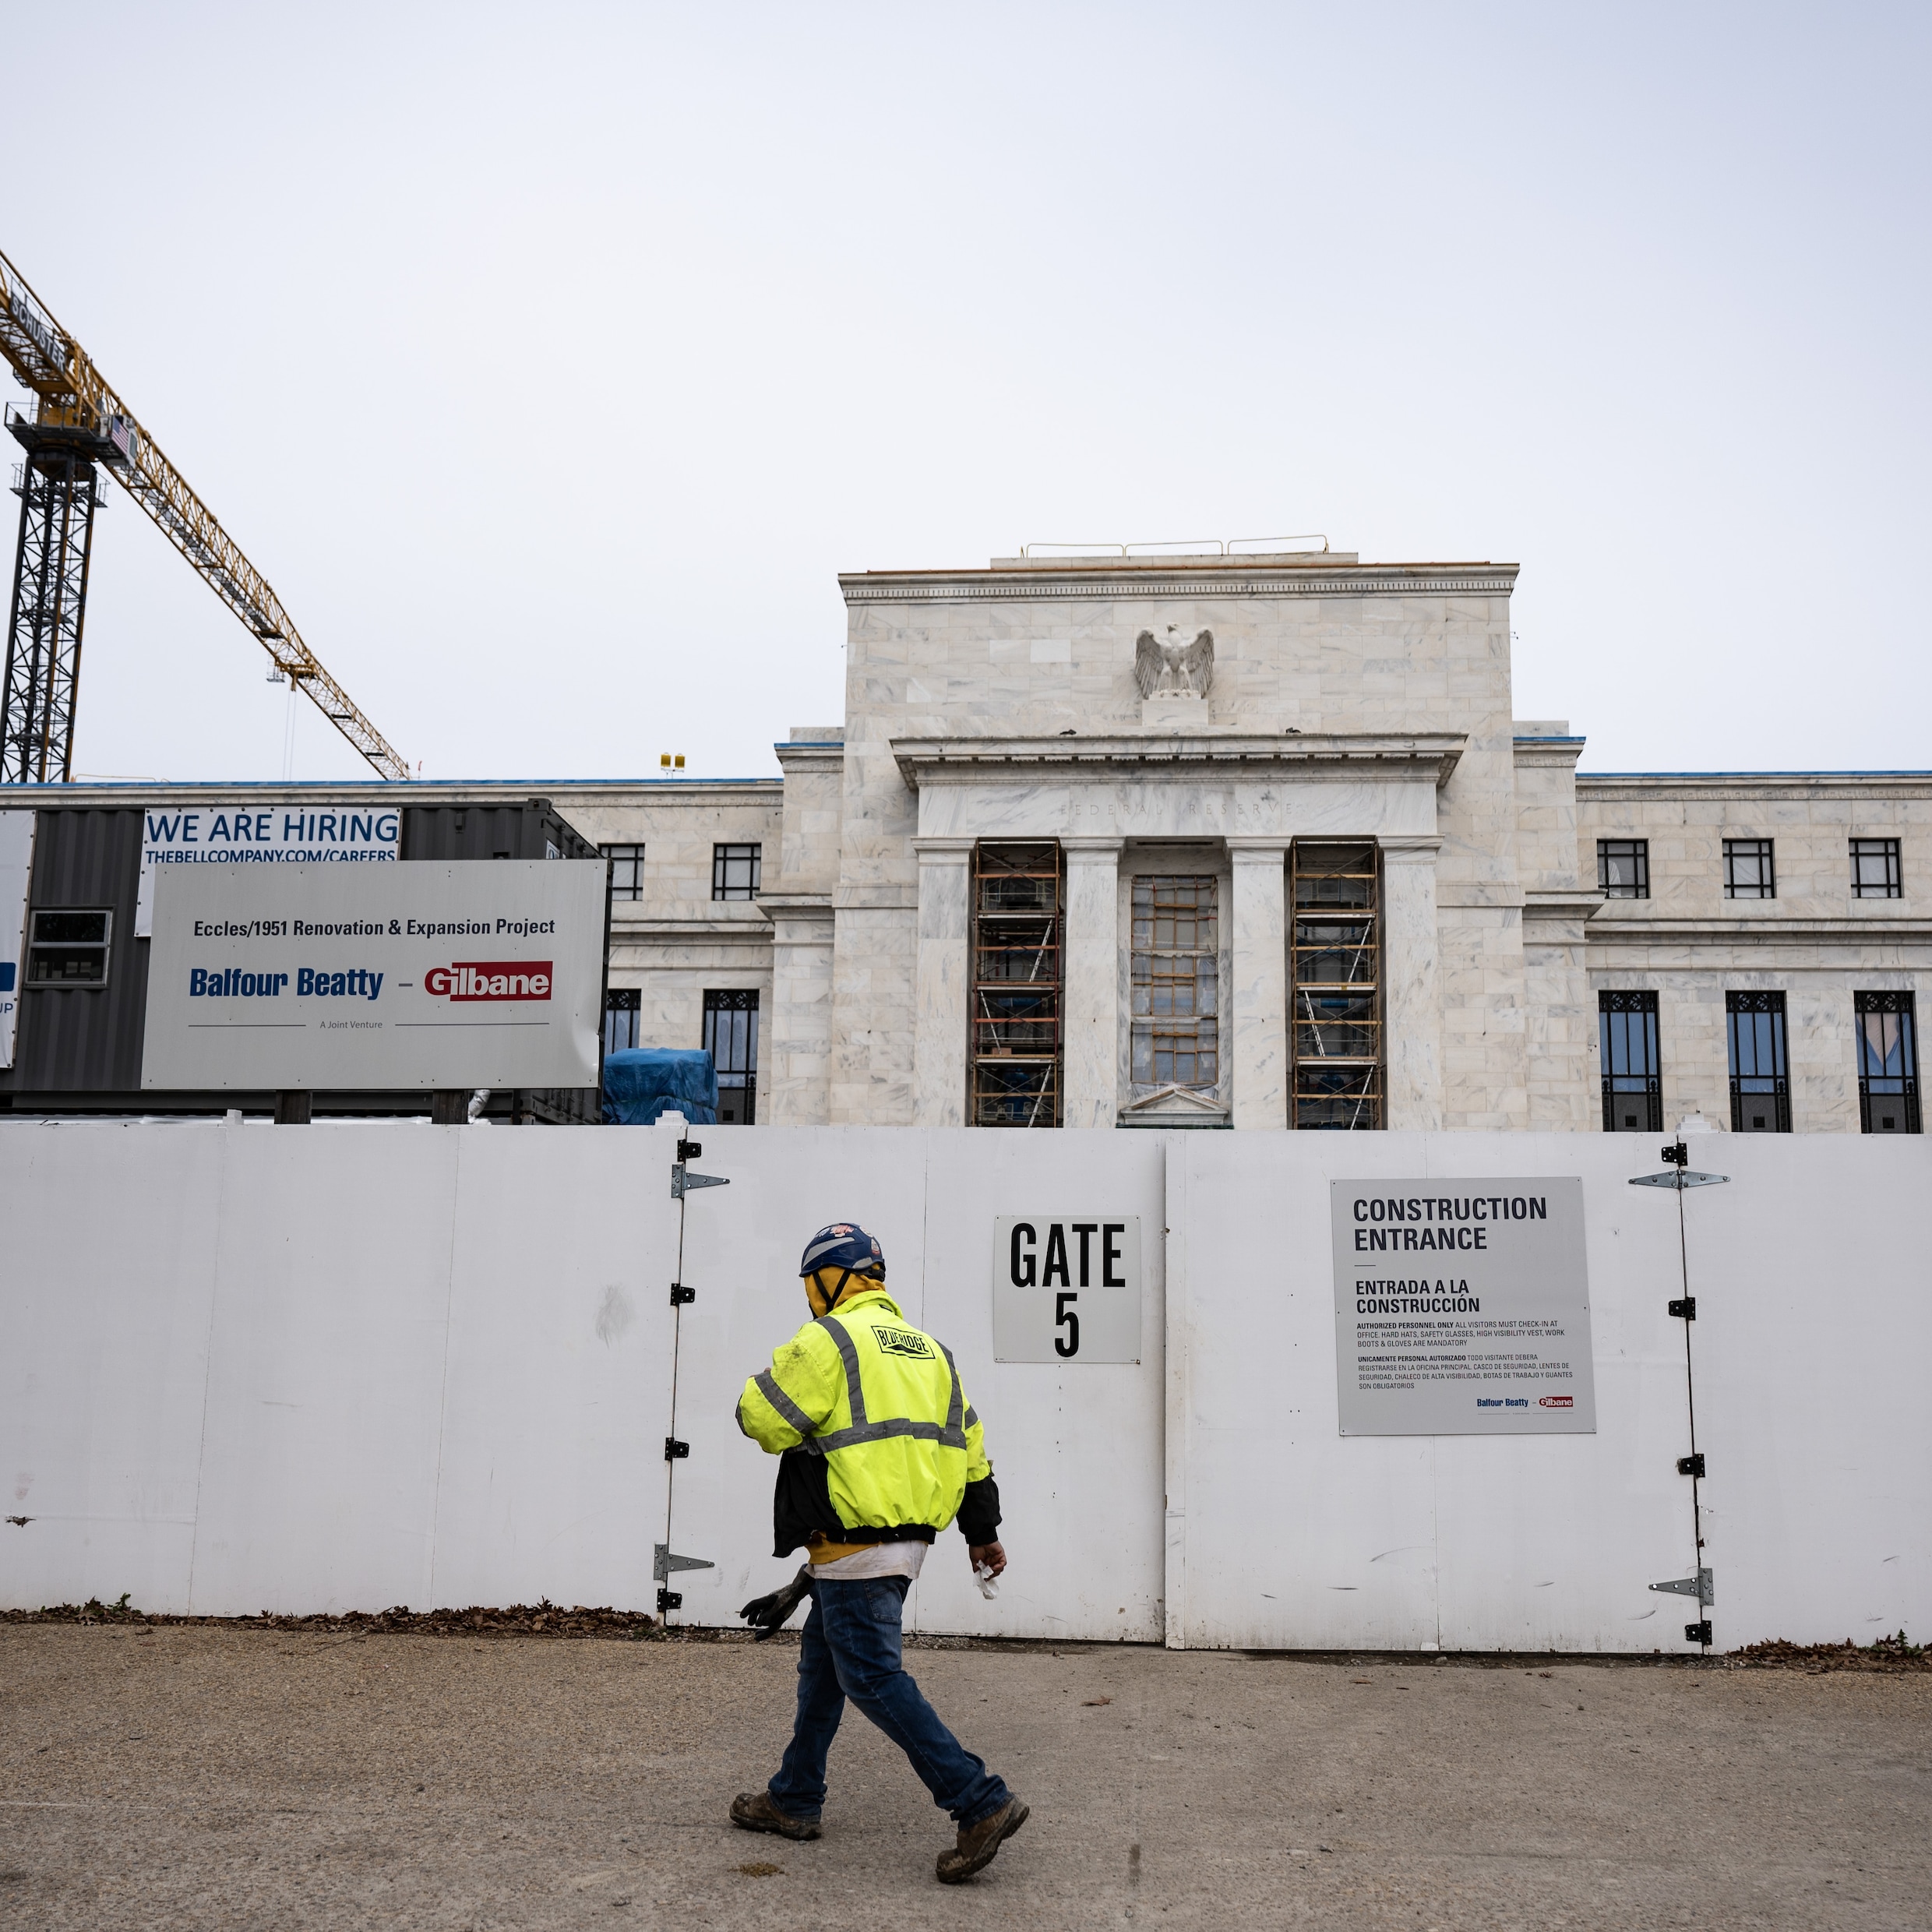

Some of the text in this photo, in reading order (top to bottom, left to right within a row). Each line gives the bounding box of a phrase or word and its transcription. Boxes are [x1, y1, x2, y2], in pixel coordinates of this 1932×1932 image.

[12, 294, 65, 373] SCHUSTER
[1060, 803, 1292, 816] FEDERAL RESERVE
[146, 813, 399, 843] WE ARE HIRING
[145, 848, 395, 863] THEBELLCOMPANY.COM/CAREERS
[194, 918, 555, 940] Eccles/1951 Renovation & Expansion Project
[189, 968, 288, 997] Balfour
[297, 968, 384, 1000] Beatty
[424, 967, 550, 996] Gilbane
[319, 1021, 383, 1030] A Joint Venture
[1353, 1197, 1547, 1222] CONSTRUCTION
[1354, 1227, 1487, 1251] ENTRANCE
[1010, 1222, 1126, 1288] GATE
[1356, 1279, 1470, 1295] ENTRADA A LA
[1356, 1294, 1480, 1314] CONSTRUCCIÓN
[1054, 1292, 1080, 1358] 5
[1401, 1331, 1419, 1339] HATS,
[877, 1329, 929, 1353] BLUERIDGE
[1477, 1398, 1504, 1407] Balfour
[1505, 1398, 1528, 1408] Beatty
[1539, 1398, 1573, 1407] Gilbane
